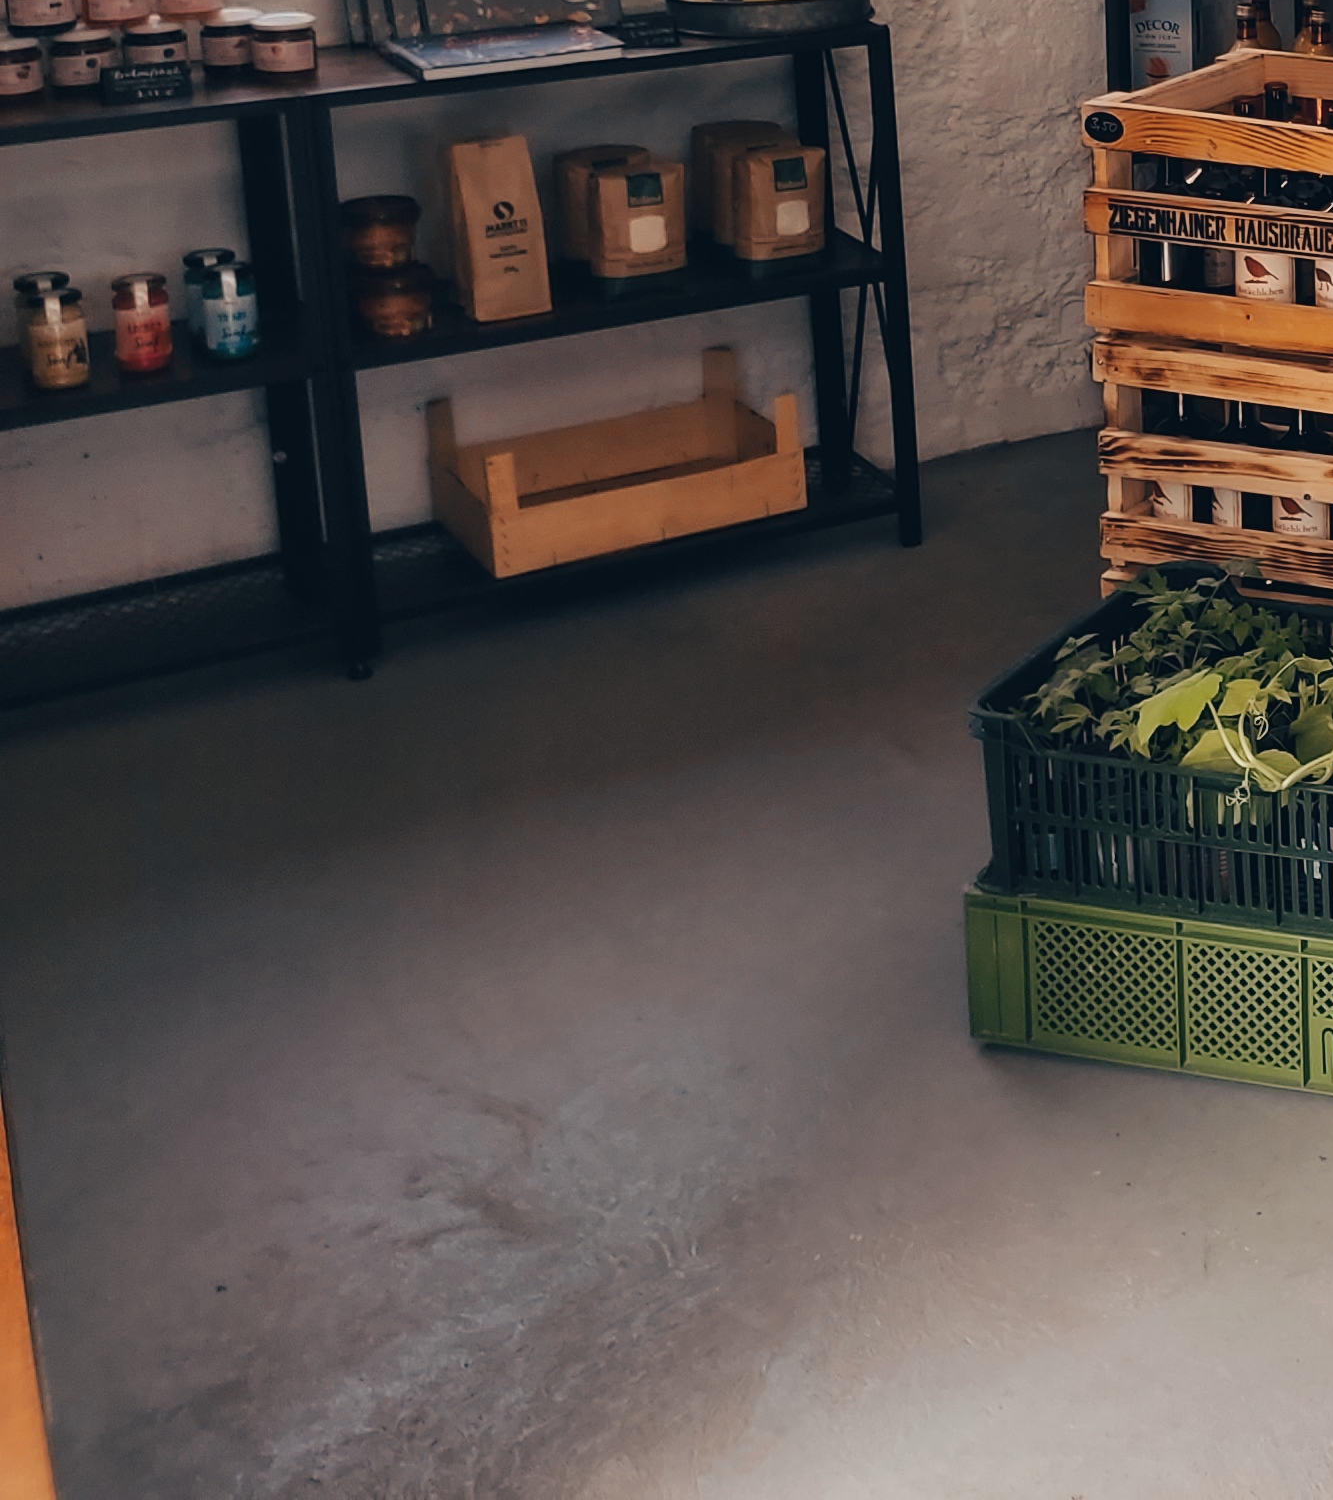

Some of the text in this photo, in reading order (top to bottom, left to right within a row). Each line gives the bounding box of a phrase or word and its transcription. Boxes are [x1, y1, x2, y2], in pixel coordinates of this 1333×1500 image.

[1135, 19, 1180, 35] DECOR
[1090, 115, 1118, 134] 3,50
[1108, 202, 1226, 242] ZIEGENHAINER
